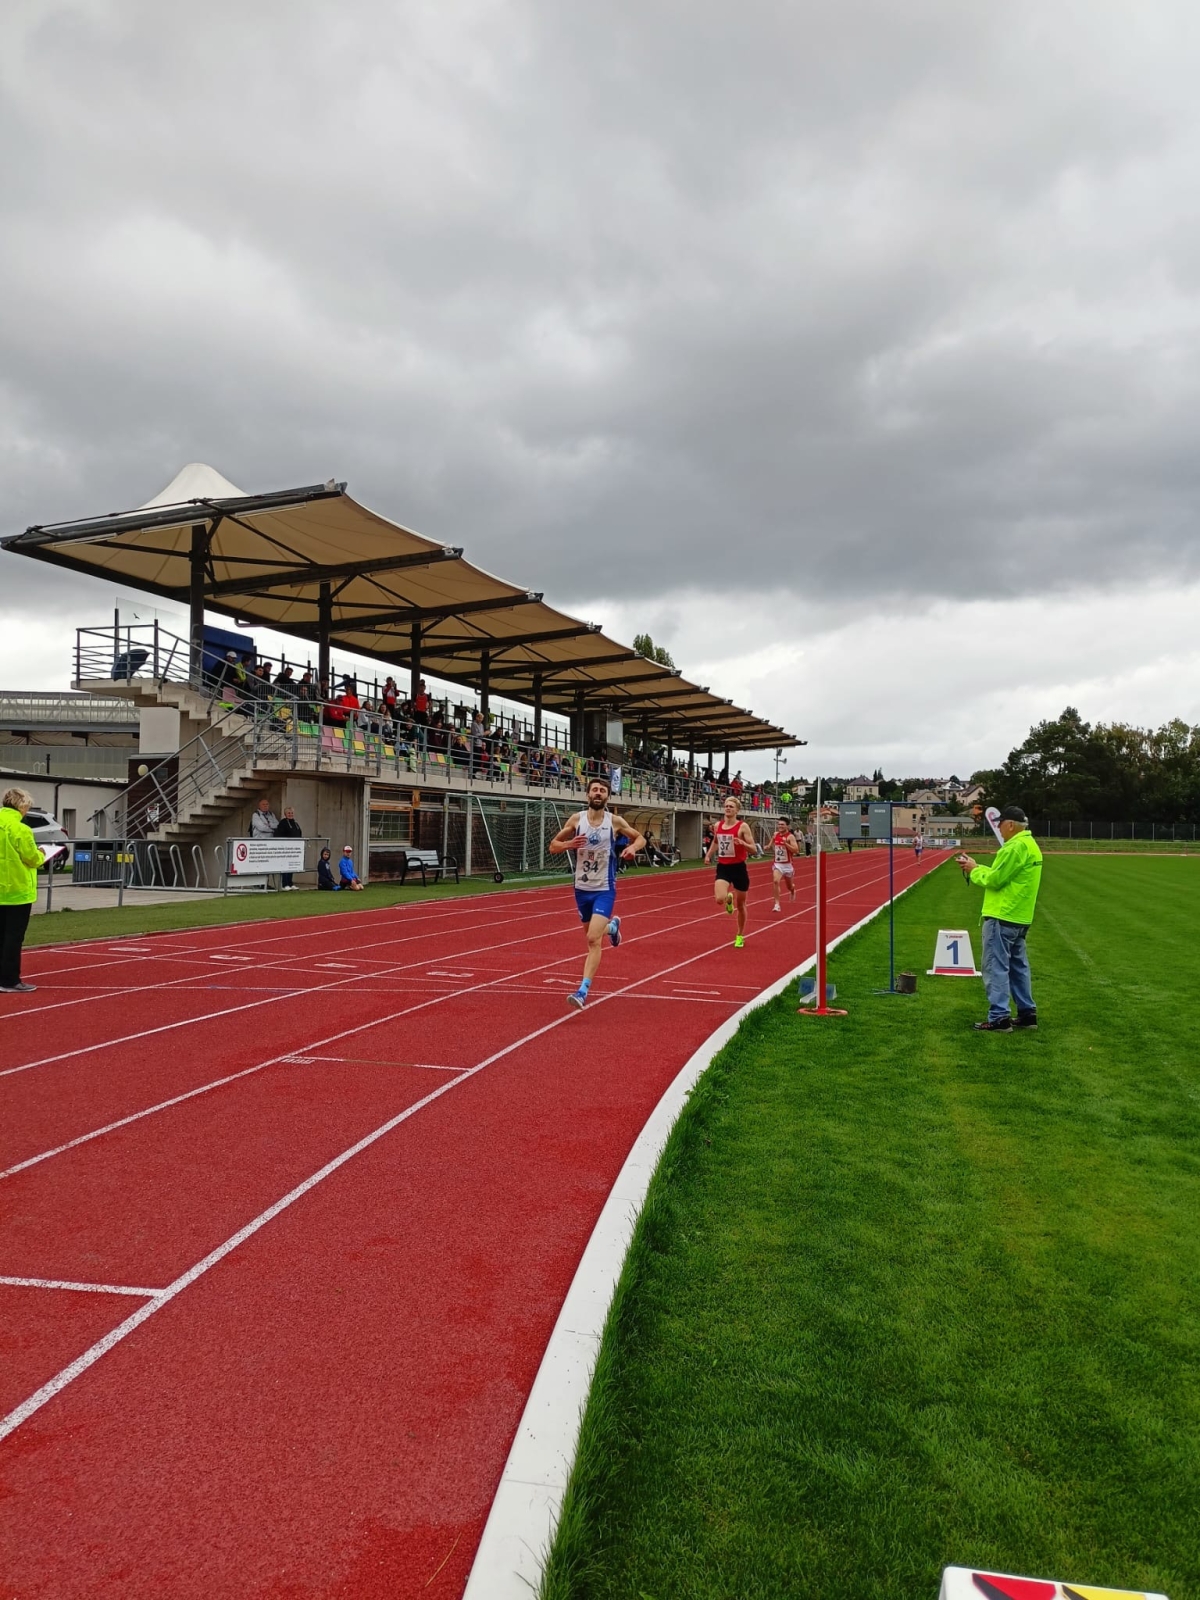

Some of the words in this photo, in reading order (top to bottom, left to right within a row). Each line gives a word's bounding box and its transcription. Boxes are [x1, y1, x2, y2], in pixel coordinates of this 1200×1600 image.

[720, 841, 730, 851] 37
[583, 860, 599, 873] 34
[946, 940, 959, 965] 1
